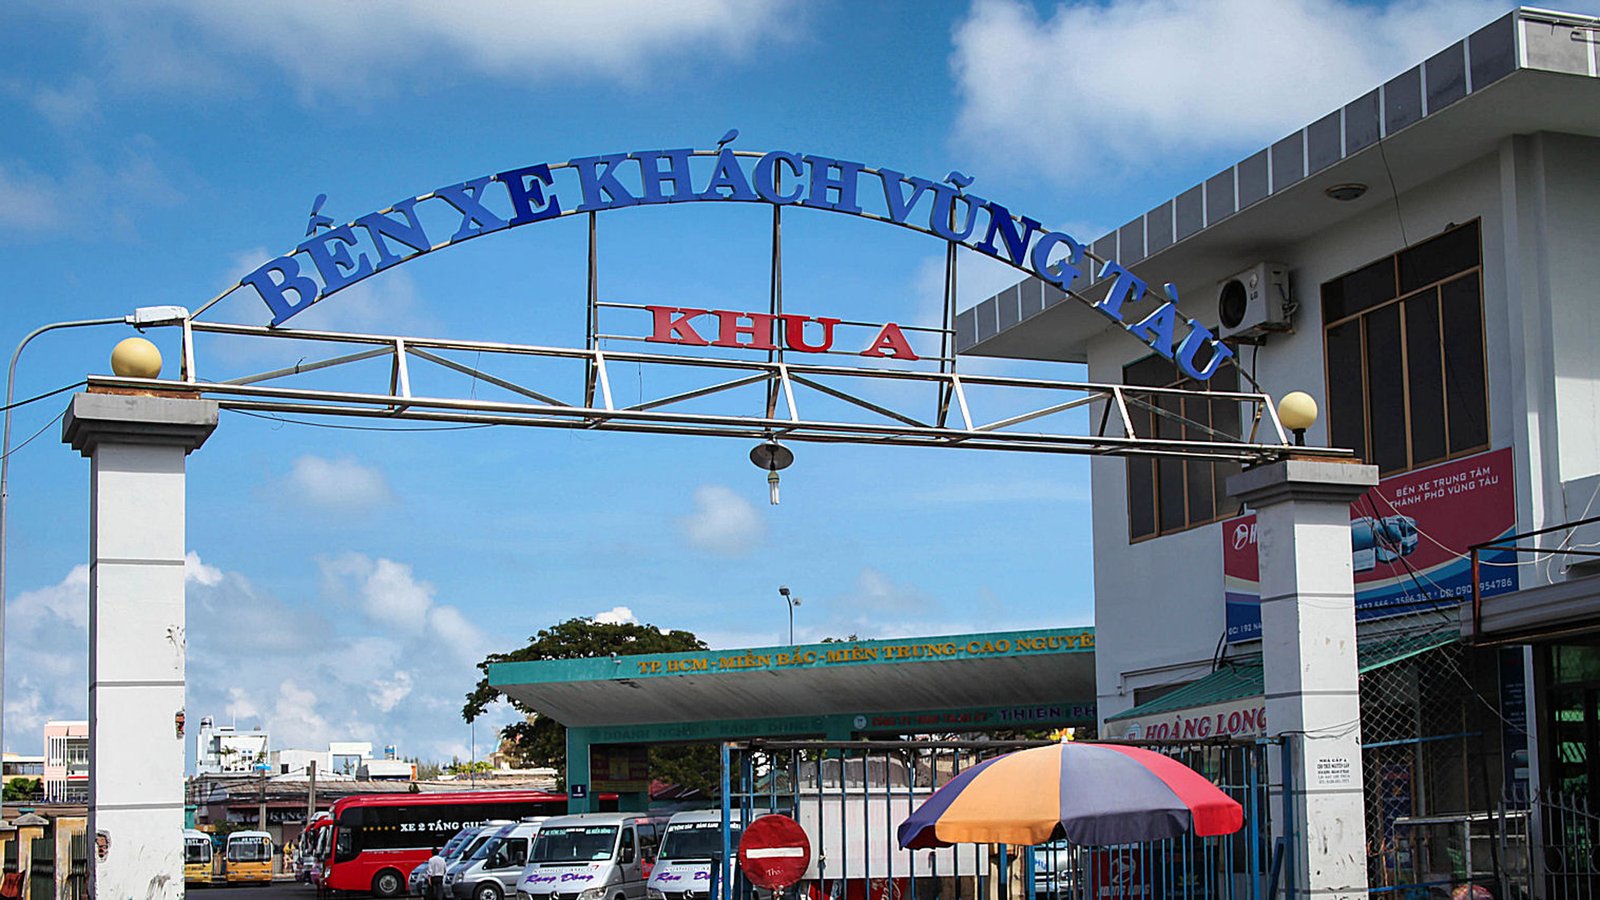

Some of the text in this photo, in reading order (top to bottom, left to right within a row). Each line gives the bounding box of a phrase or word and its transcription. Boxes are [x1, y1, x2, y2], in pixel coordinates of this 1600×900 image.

[241, 129, 1235, 381] BẾN XE KHÁCH VŨNG TÀU
[645, 305, 920, 360] KHU A
[1418, 481, 1431, 492] XE
[1433, 472, 1467, 488] TRUNG
[637, 660, 662, 674] TP.
[1144, 706, 1267, 740] HOÀNG LONG
[400, 823, 416, 832] XE
[418, 822, 426, 832] 2
